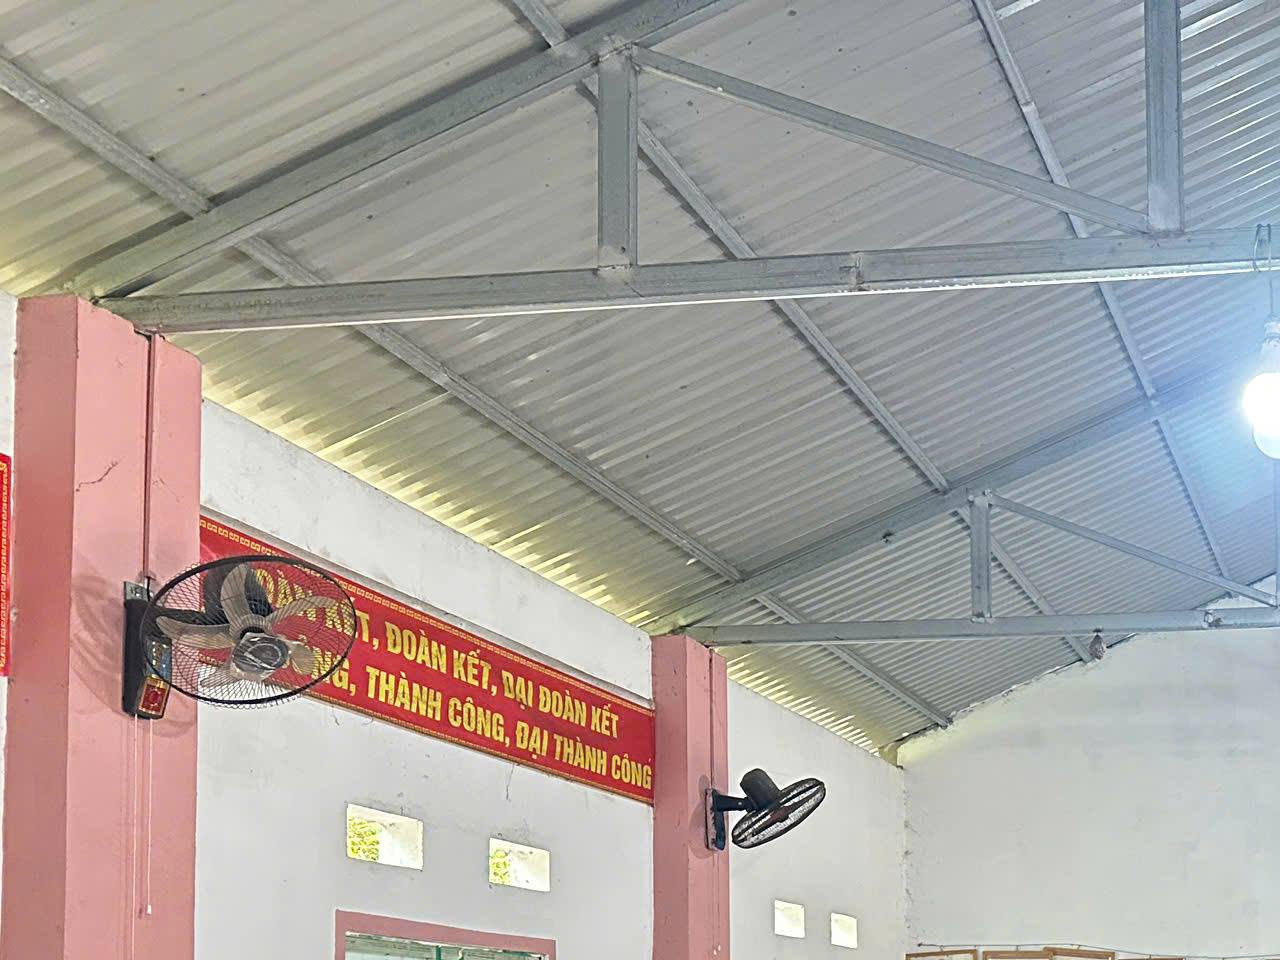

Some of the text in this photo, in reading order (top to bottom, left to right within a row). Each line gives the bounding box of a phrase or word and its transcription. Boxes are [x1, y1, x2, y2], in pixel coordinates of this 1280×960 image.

[366, 665, 441, 721] THÀNH
[448, 696, 510, 748] CÔNG,
[515, 720, 549, 760] ĐẠI
[553, 733, 607, 776] THÀNH
[611, 753, 652, 790] CÔNG
[384, 621, 447, 674] ĐOÀN
[453, 648, 497, 696] KẾT,
[501, 670, 534, 709] ĐẠI
[538, 684, 587, 727] ĐOÀN
[590, 703, 619, 738] KẾT
